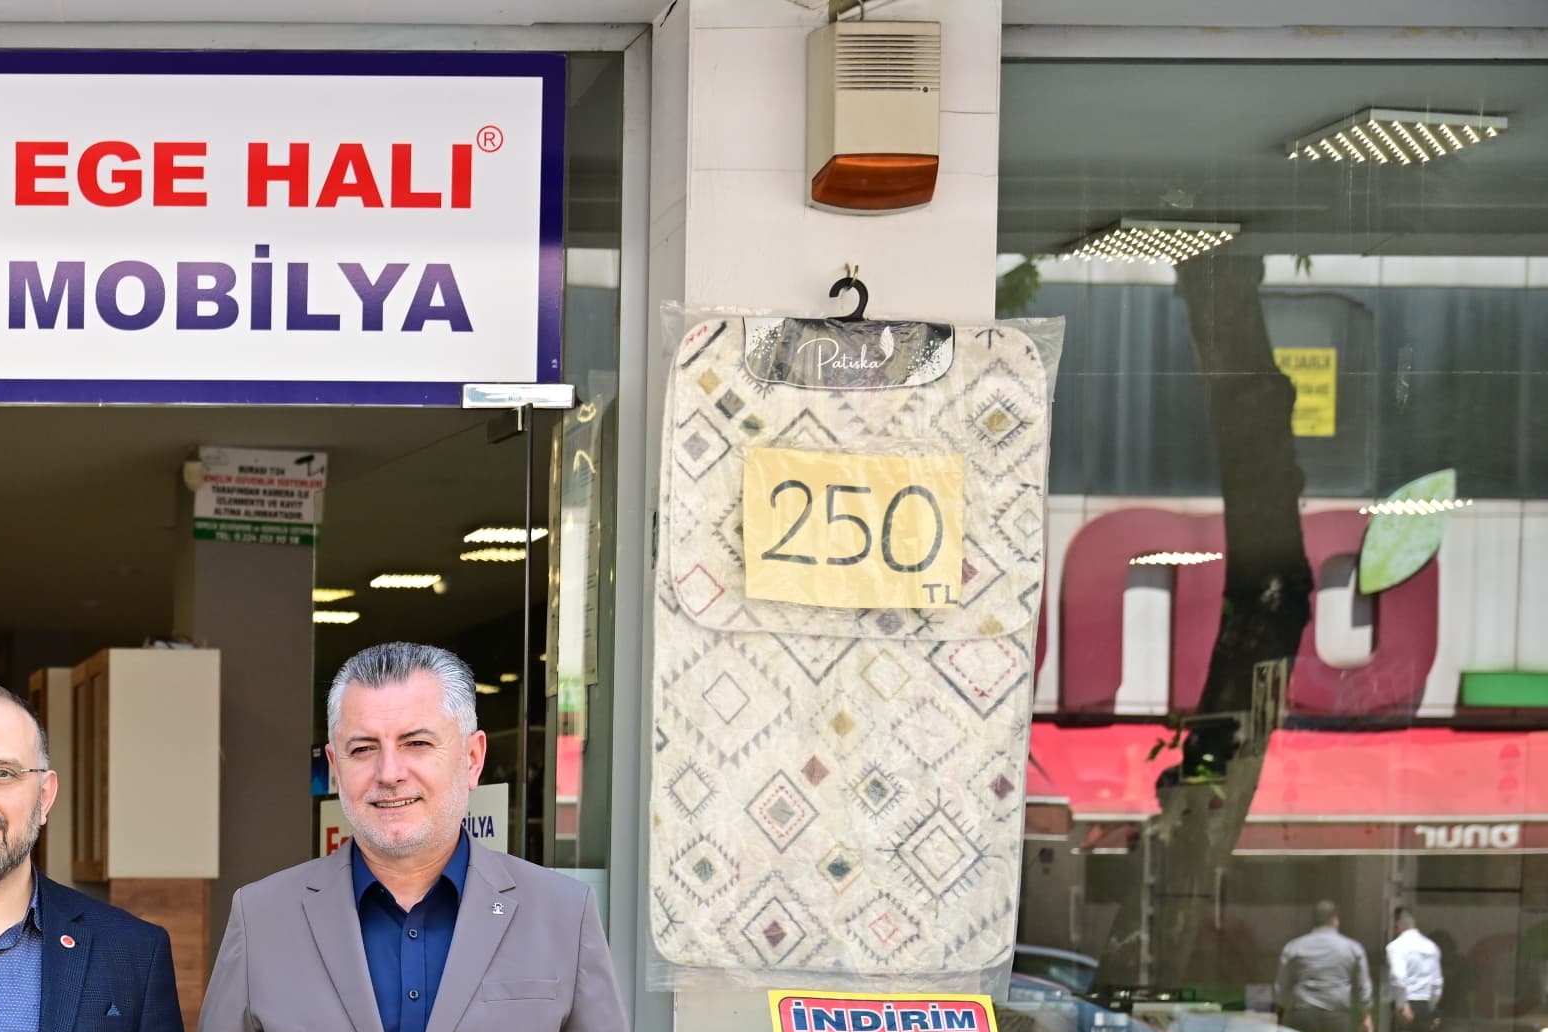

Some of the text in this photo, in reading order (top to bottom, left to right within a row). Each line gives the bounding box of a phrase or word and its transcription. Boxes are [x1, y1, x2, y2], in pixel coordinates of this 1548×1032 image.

[14, 140, 473, 209] EGE HALI
[7, 243, 475, 333] MOBİLYA
[796, 336, 882, 380] Patiska
[761, 479, 944, 573] 250
[921, 583, 958, 606] TL
[792, 1000, 978, 1032] İNDİRİM
